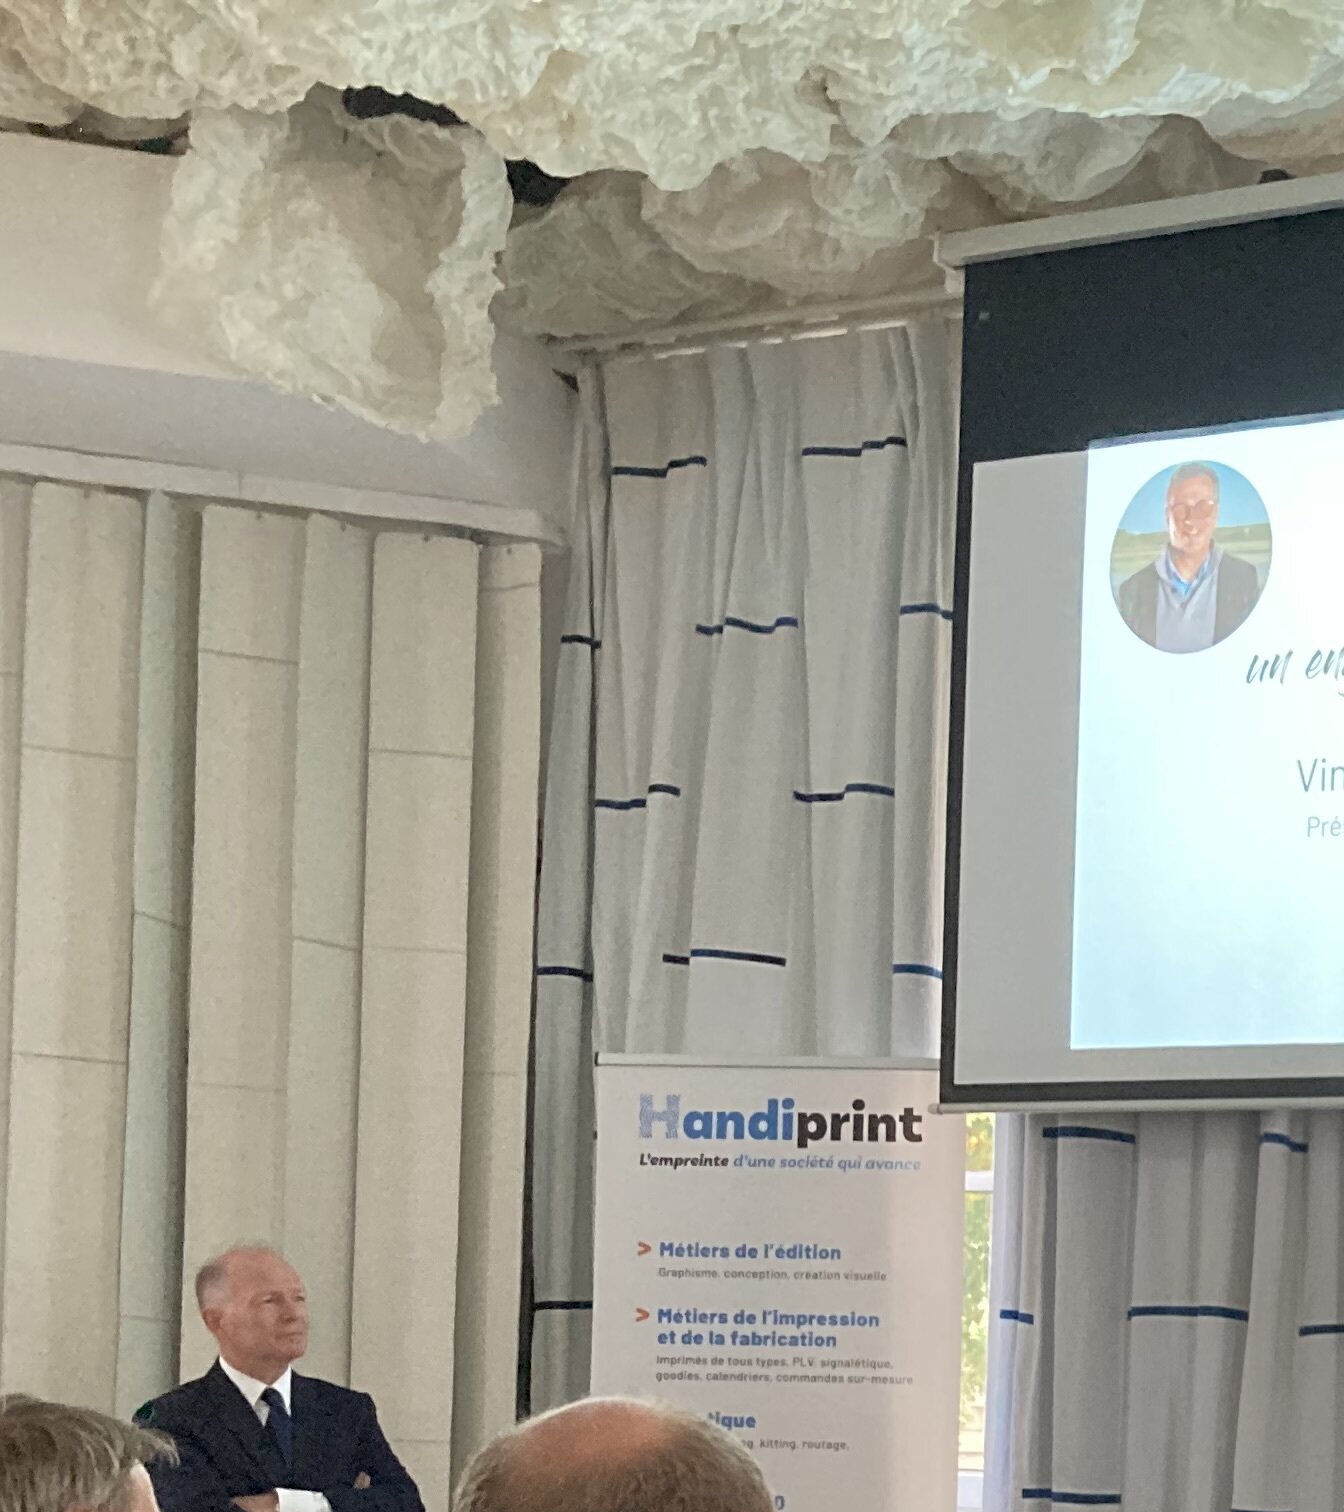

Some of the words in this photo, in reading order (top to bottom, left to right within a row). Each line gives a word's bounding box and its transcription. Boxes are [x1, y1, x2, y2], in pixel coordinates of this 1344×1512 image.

[1246, 646, 1293, 685] un
[638, 1094, 923, 1148] Handiprint
[639, 1153, 729, 1170] L'empreinte
[733, 1154, 776, 1169] d'une
[837, 1155, 862, 1172] qui
[865, 1158, 921, 1170] avance
[659, 1242, 729, 1258] Métiers
[735, 1243, 758, 1259] de
[657, 1309, 727, 1325] Métiers
[733, 1309, 757, 1325] de
[657, 1331, 676, 1345] et
[681, 1330, 703, 1345] de
[708, 1331, 725, 1346] la
[730, 1332, 837, 1348] fabrication
[711, 1356, 725, 1367] de
[727, 1357, 753, 1367] tous
[776, 1373, 845, 1383] commandes
